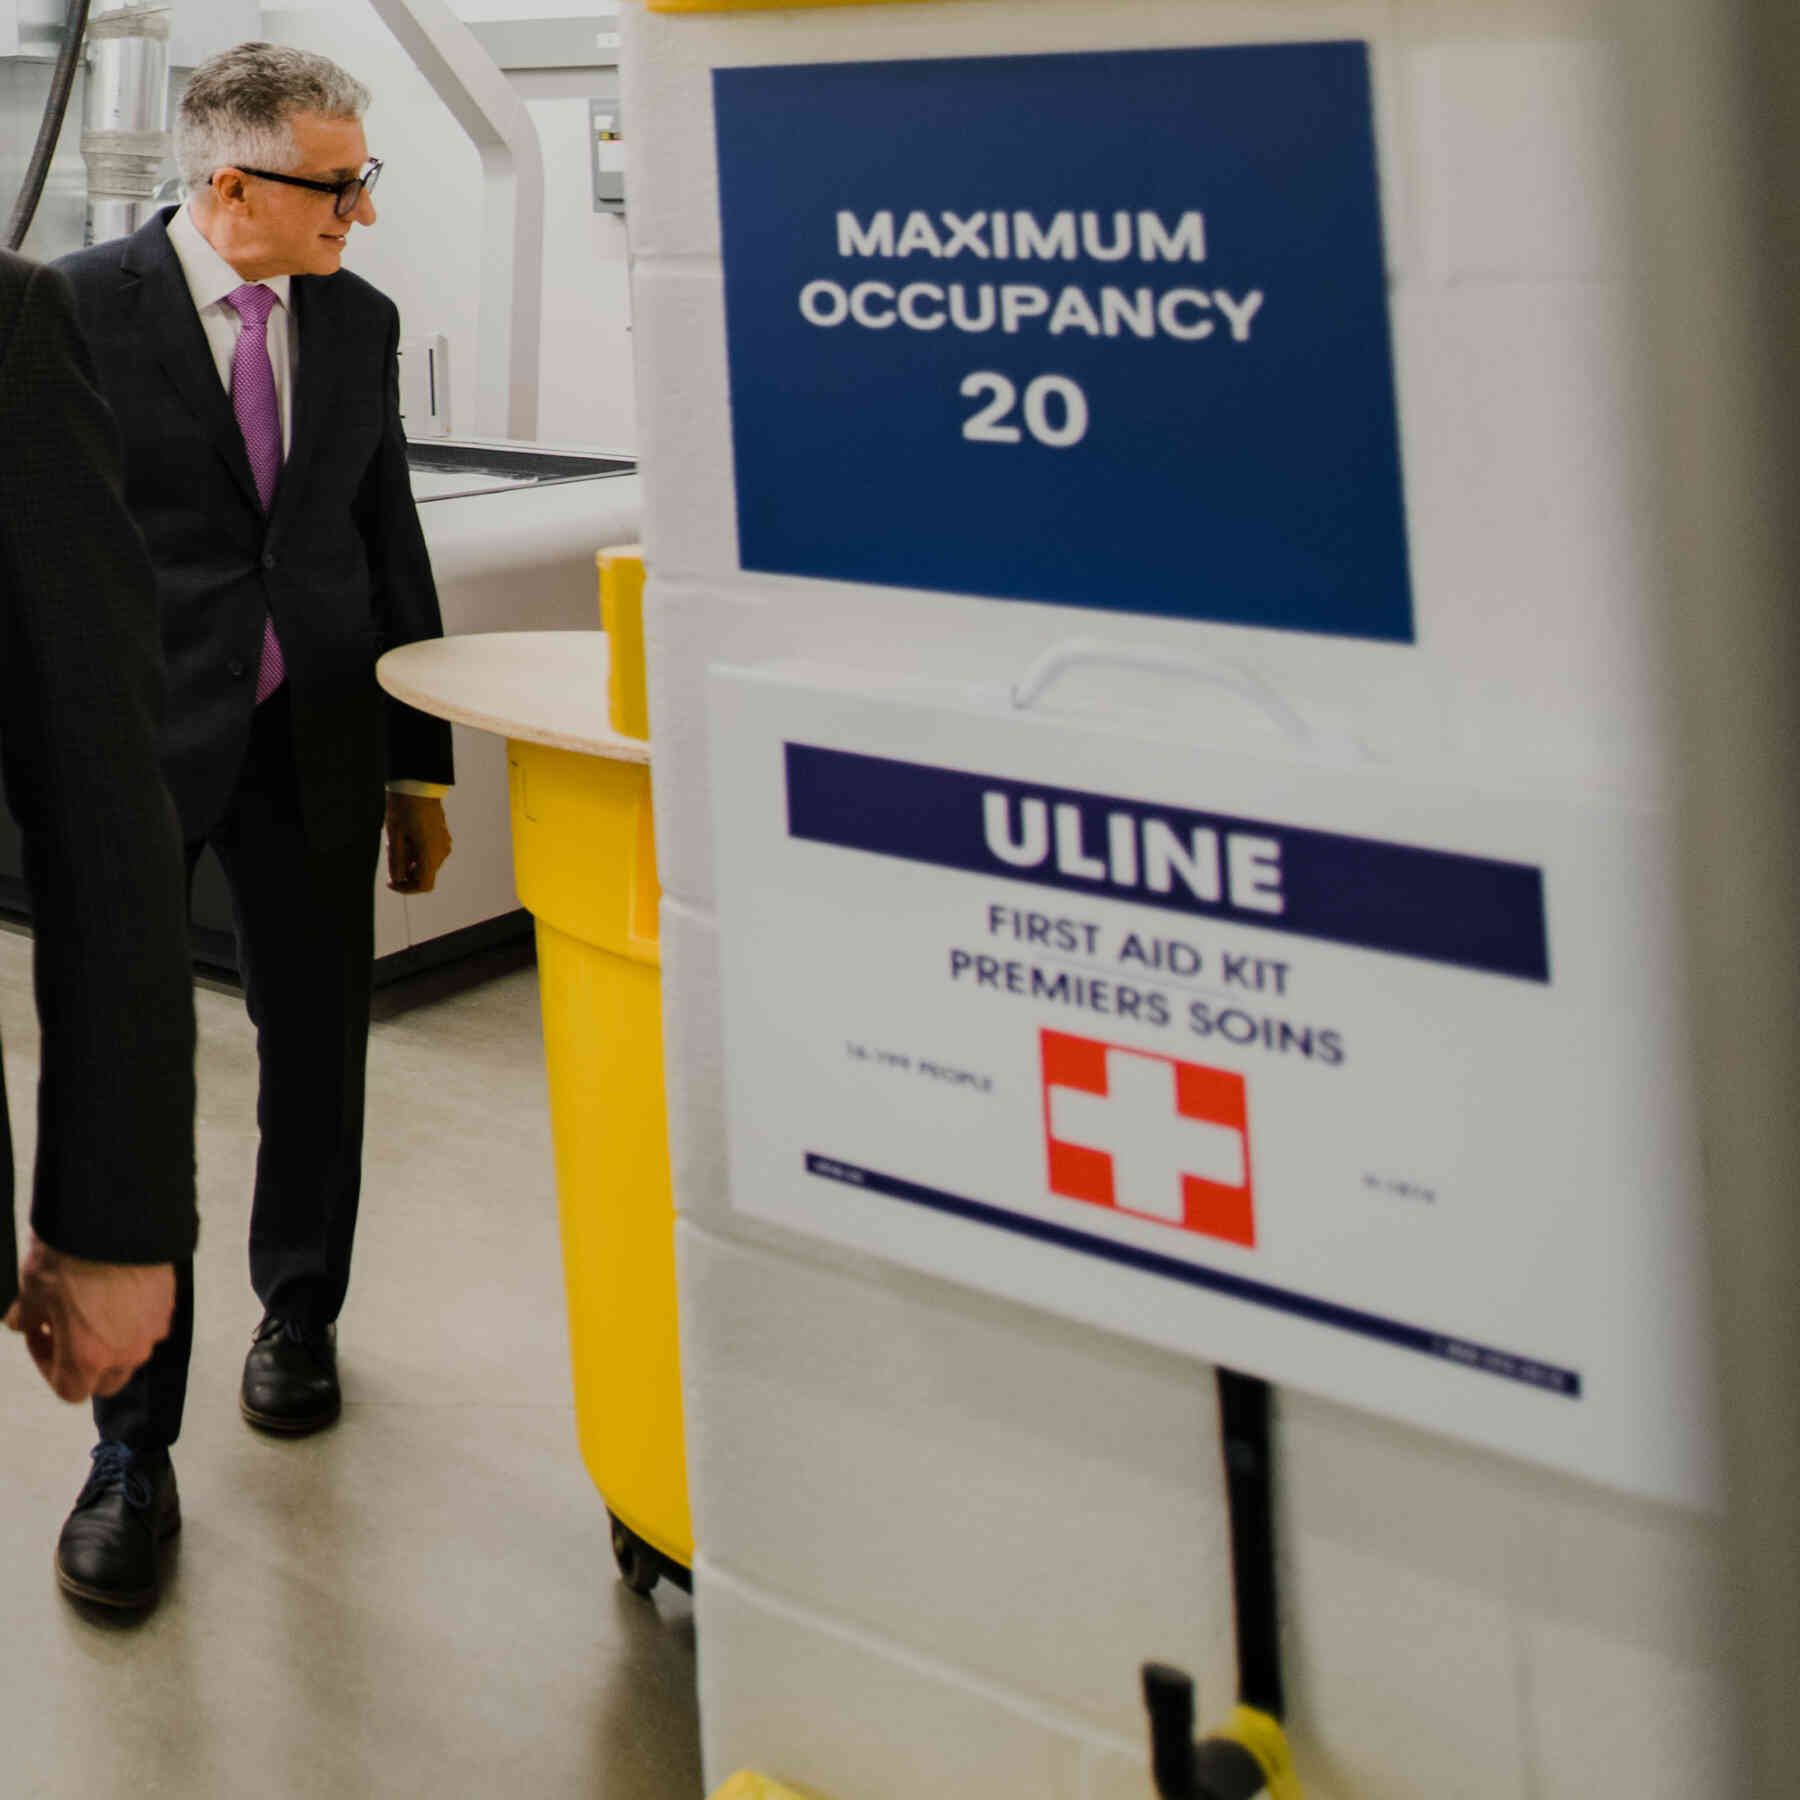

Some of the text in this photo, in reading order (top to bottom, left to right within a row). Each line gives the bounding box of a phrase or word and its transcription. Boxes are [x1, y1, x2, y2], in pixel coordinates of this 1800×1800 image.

[836, 210, 1206, 263] MAXIMUM
[799, 280, 1264, 343] OCCUPANCY
[959, 371, 1089, 448] 20
[982, 790, 1286, 915] ULINE
[987, 903, 1291, 996] FIRST AID KIT
[949, 948, 1344, 1066] PREMIERS SOINS
